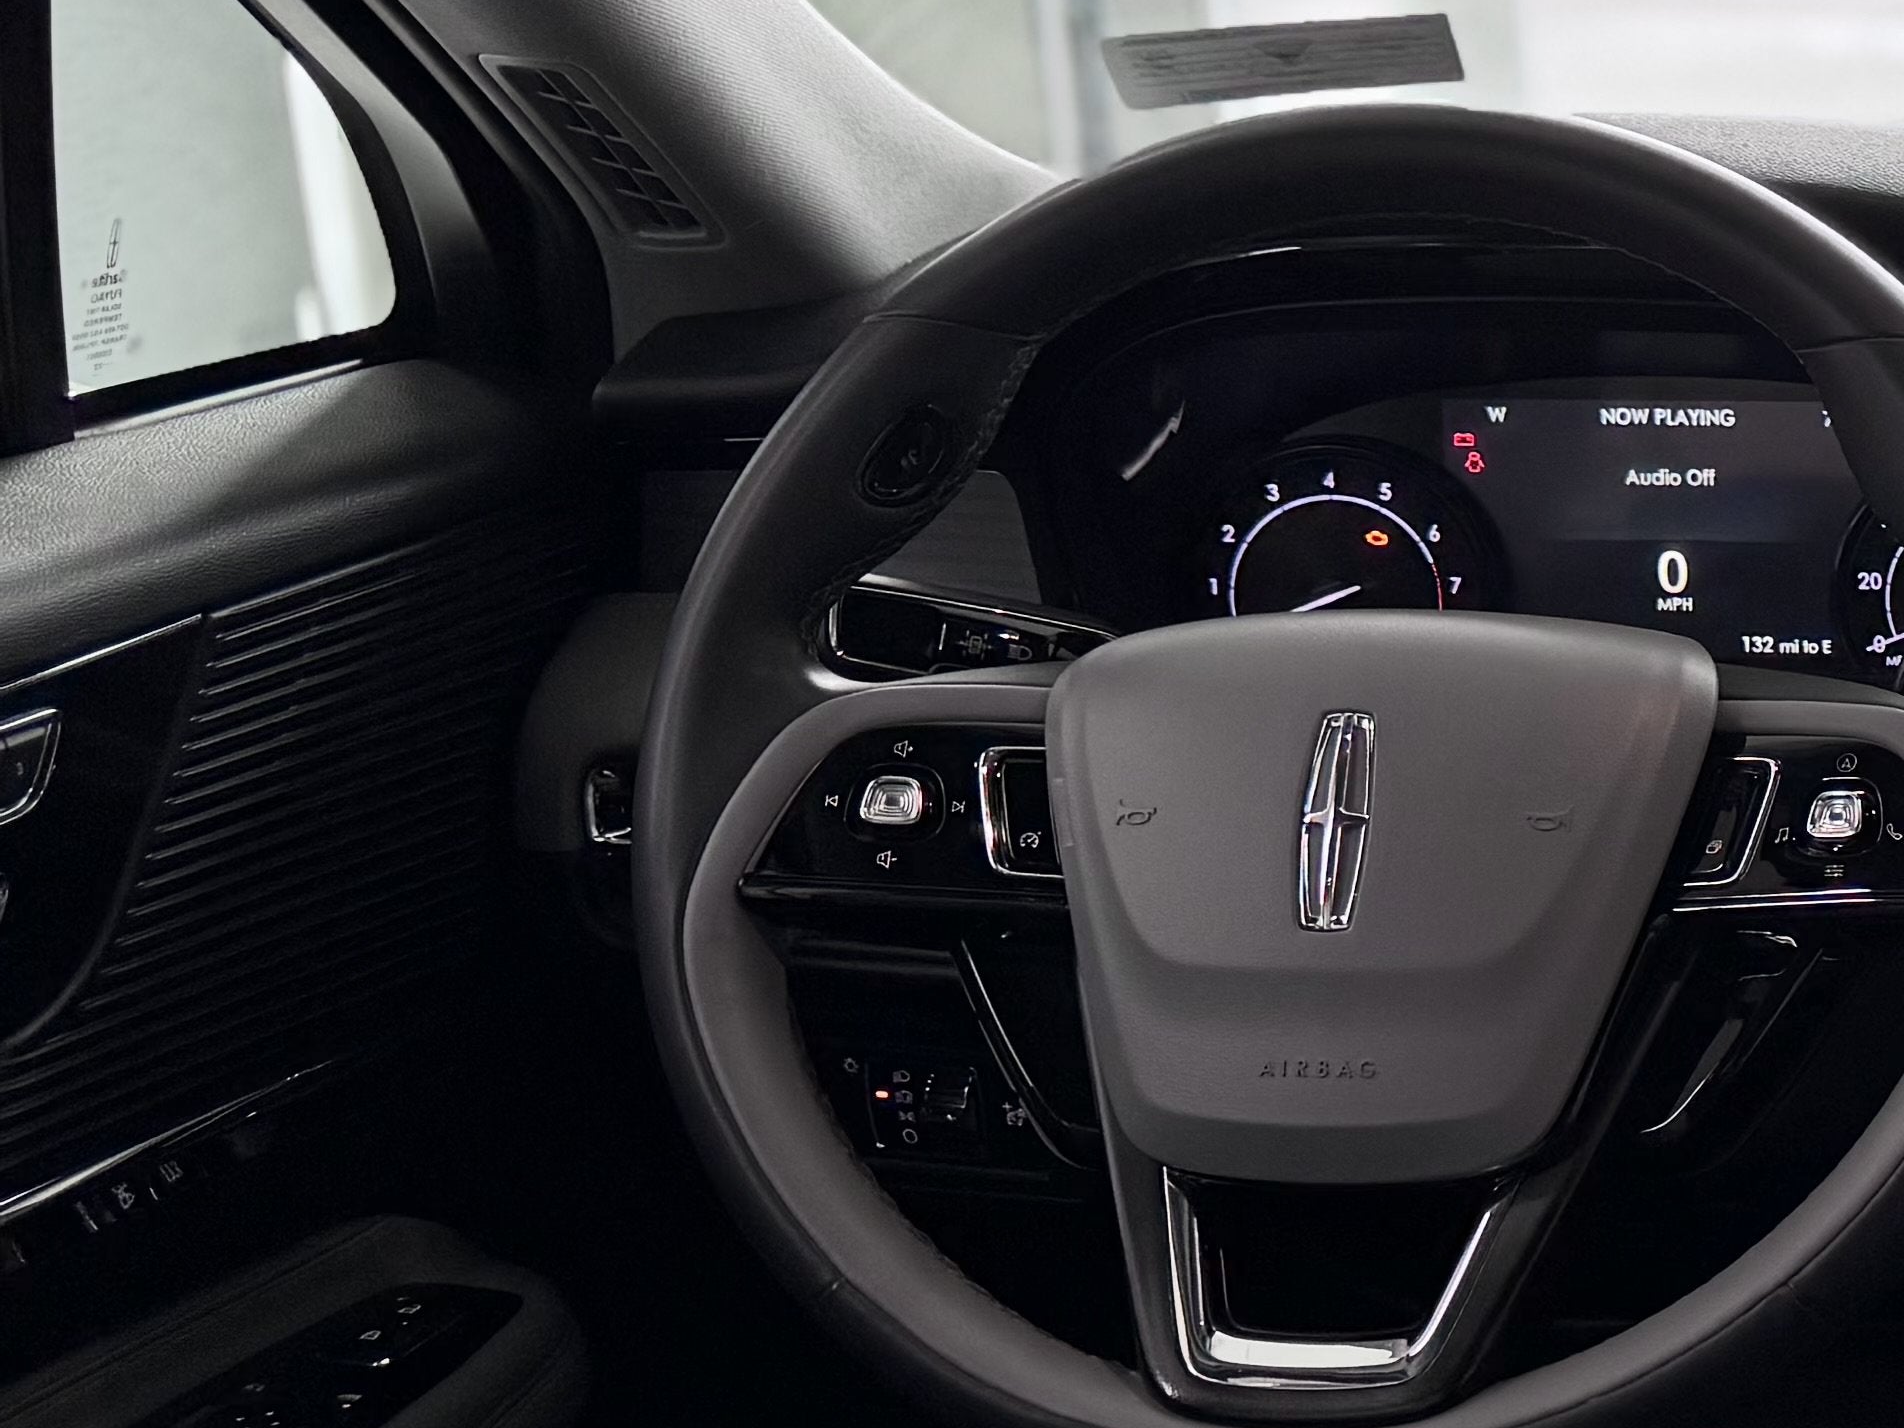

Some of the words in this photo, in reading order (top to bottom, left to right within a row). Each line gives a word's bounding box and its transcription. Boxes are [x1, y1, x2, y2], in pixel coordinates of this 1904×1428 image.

[1600, 408, 1650, 426] NOW
[1654, 408, 1736, 427] PLAYING
[1324, 472, 1335, 489] 4
[1625, 469, 1682, 487] Audio
[1686, 469, 1716, 486] Off
[1264, 483, 1281, 502] 3
[1379, 483, 1393, 501] 5
[1221, 524, 1235, 543] 2
[1427, 524, 1440, 542] 6
[1657, 549, 1689, 595] 0
[1857, 572, 1883, 591] 20
[1208, 577, 1218, 596] 1
[1448, 576, 1463, 594] 7
[1657, 597, 1693, 612] MPH
[1741, 635, 1774, 654] 132
[1778, 638, 1800, 654] mi
[1802, 639, 1819, 654] to
[1822, 639, 1832, 654] E
[1260, 1060, 1375, 1079] AIRBAG
